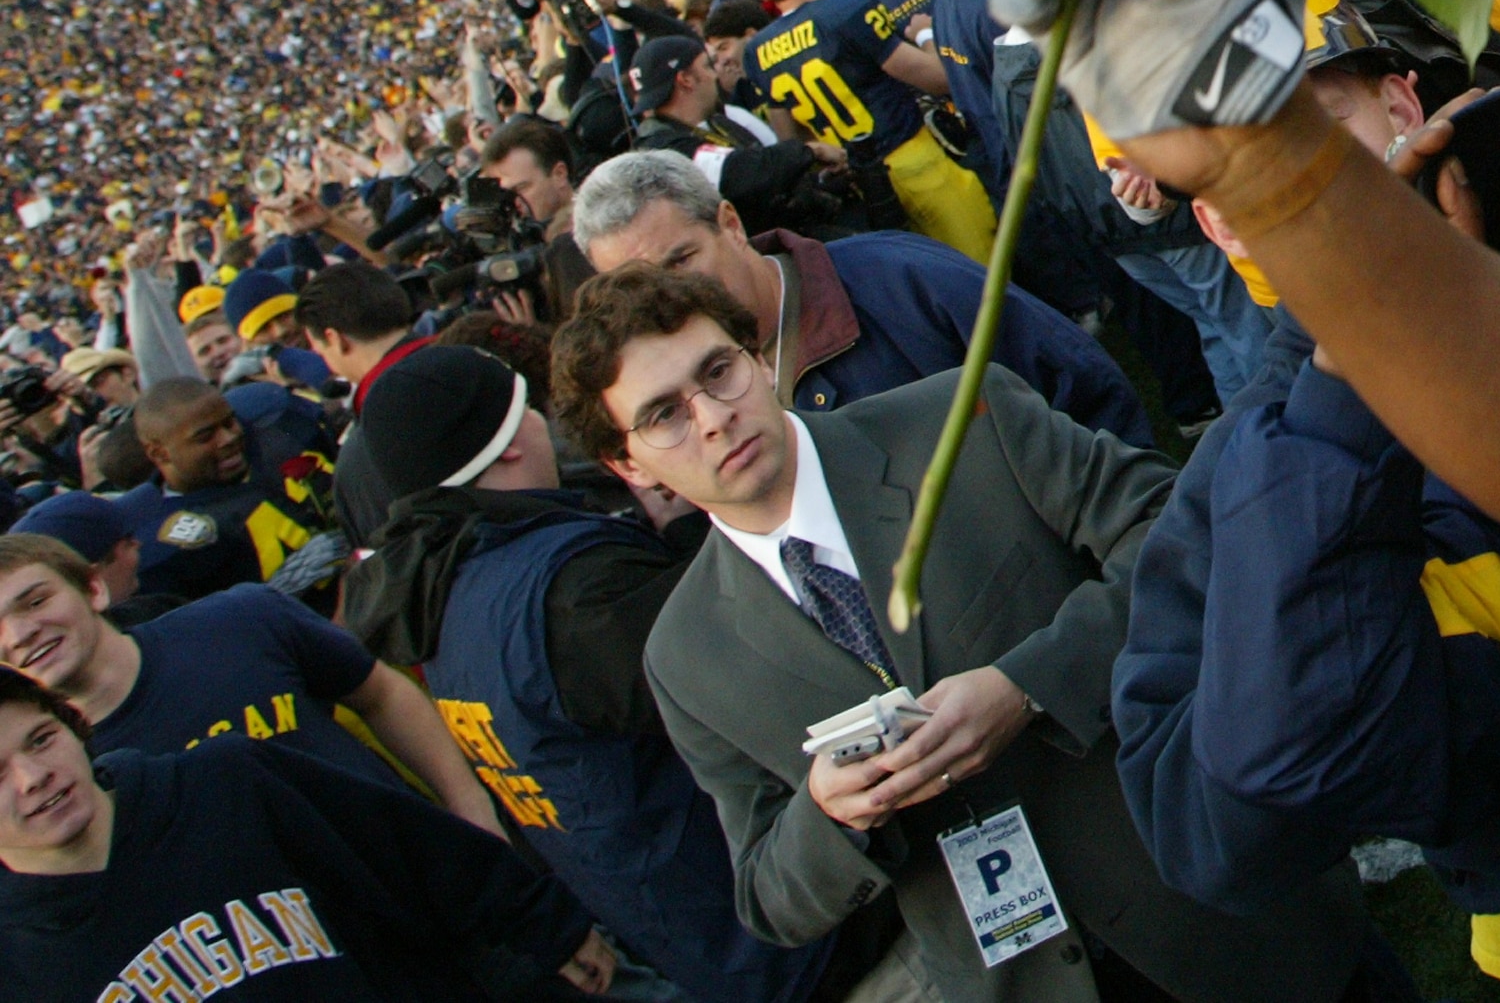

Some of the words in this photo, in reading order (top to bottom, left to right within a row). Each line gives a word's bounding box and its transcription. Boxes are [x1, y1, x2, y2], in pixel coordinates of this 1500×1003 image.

[756, 19, 819, 71] KASELITZ
[771, 57, 876, 148] 20
[980, 815, 1018, 836] Michigan
[986, 825, 1020, 845] Football
[976, 848, 1012, 896] P
[974, 900, 1017, 928] PRESS
[1020, 886, 1047, 908] BOX
